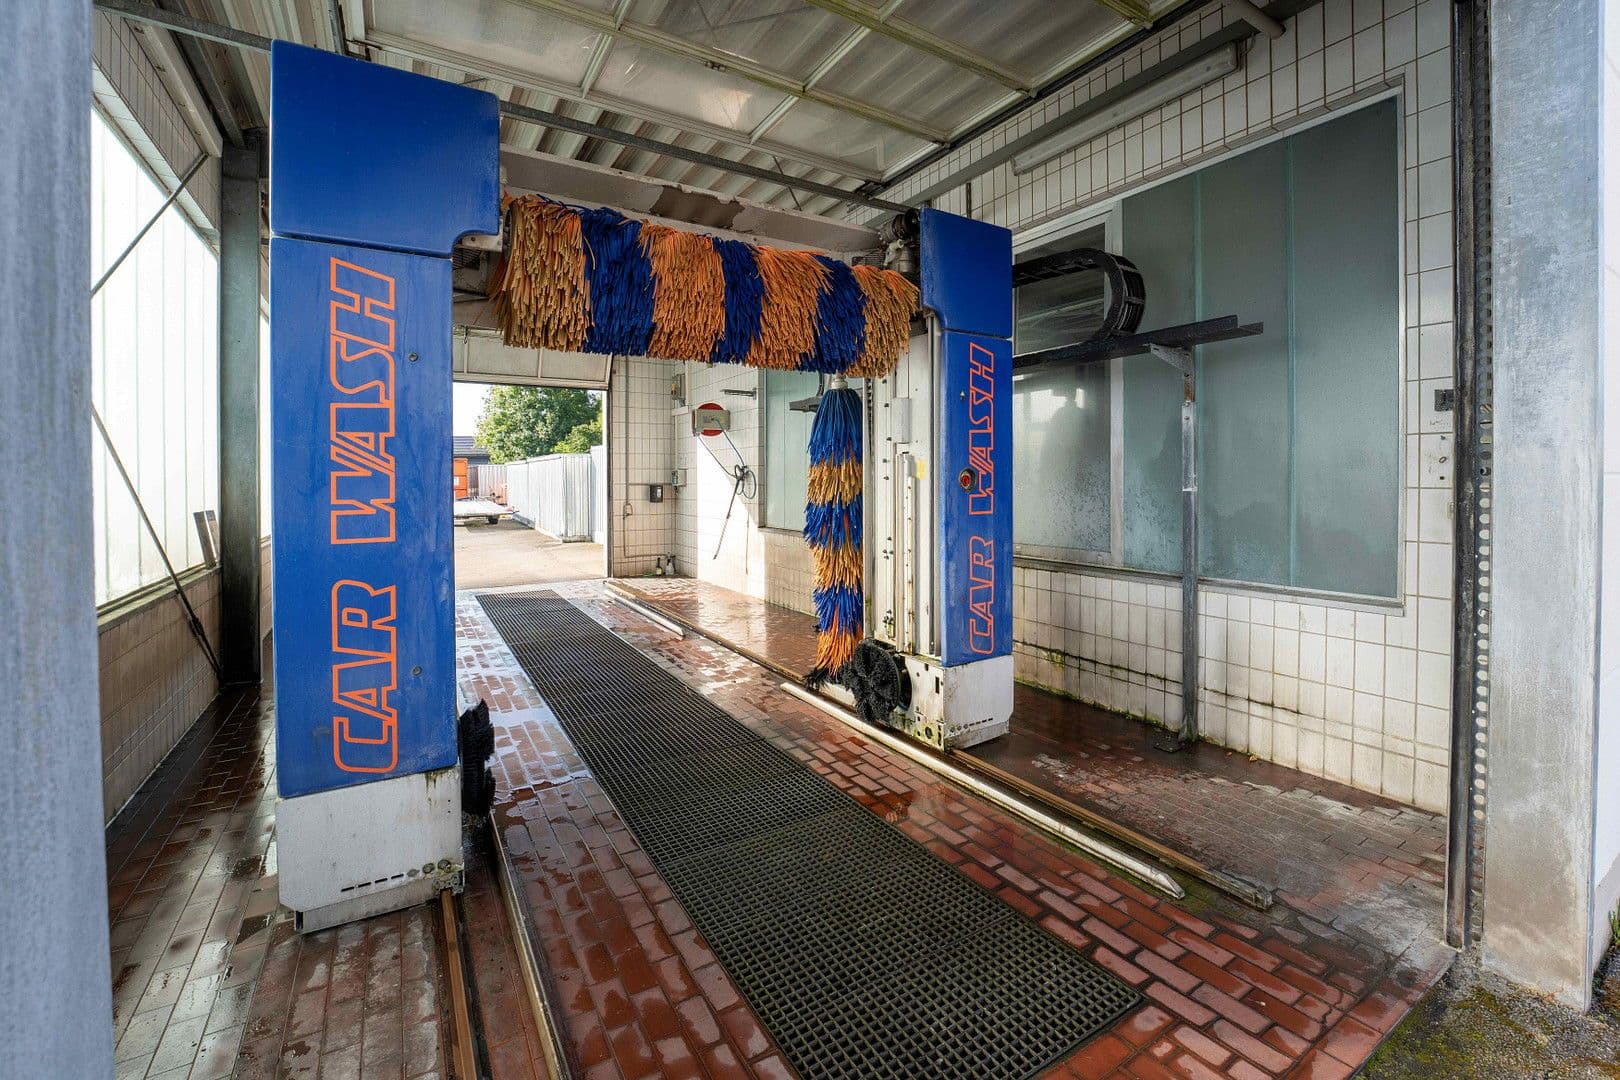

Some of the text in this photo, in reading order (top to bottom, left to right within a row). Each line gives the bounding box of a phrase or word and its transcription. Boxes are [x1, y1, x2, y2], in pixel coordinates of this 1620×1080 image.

[330, 257, 398, 773] CAR WASH
[969, 342, 994, 655] CAR WASH
